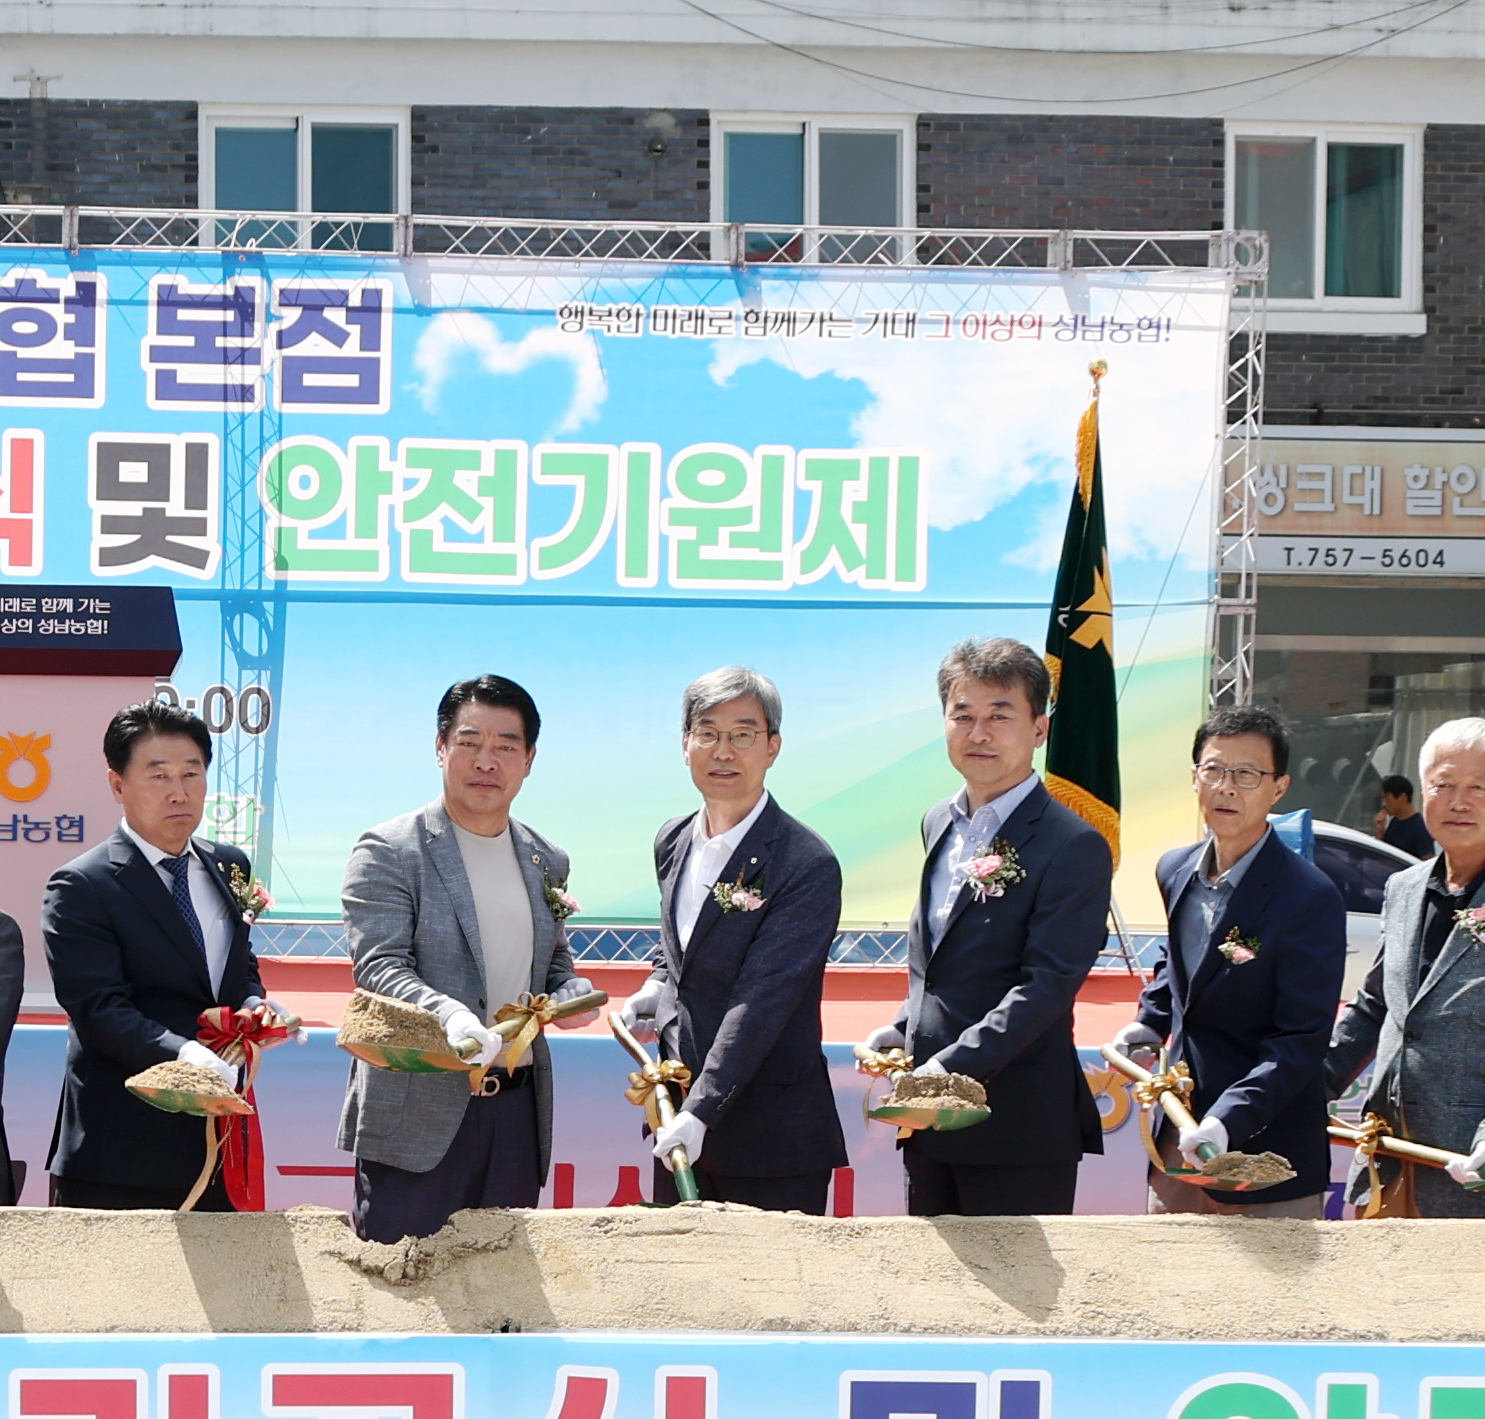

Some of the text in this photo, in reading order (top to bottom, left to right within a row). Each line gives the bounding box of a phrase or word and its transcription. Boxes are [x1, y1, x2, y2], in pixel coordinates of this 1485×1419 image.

[557, 301, 644, 334] 행복한
[651, 307, 735, 337] 미래로
[864, 309, 917, 340] 기대
[924, 312, 953, 340] 그
[962, 312, 1045, 342] 이상의
[1051, 314, 1172, 344] 성남농협!
[146, 276, 386, 408] 본점
[95, 440, 211, 572] 및
[274, 442, 921, 584] 안전기원제
[1284, 546, 1446, 568] T.757-5604
[41, 597, 74, 614] 함께
[77, 597, 111, 614] 가는
[36, 618, 109, 635] 성남농협!
